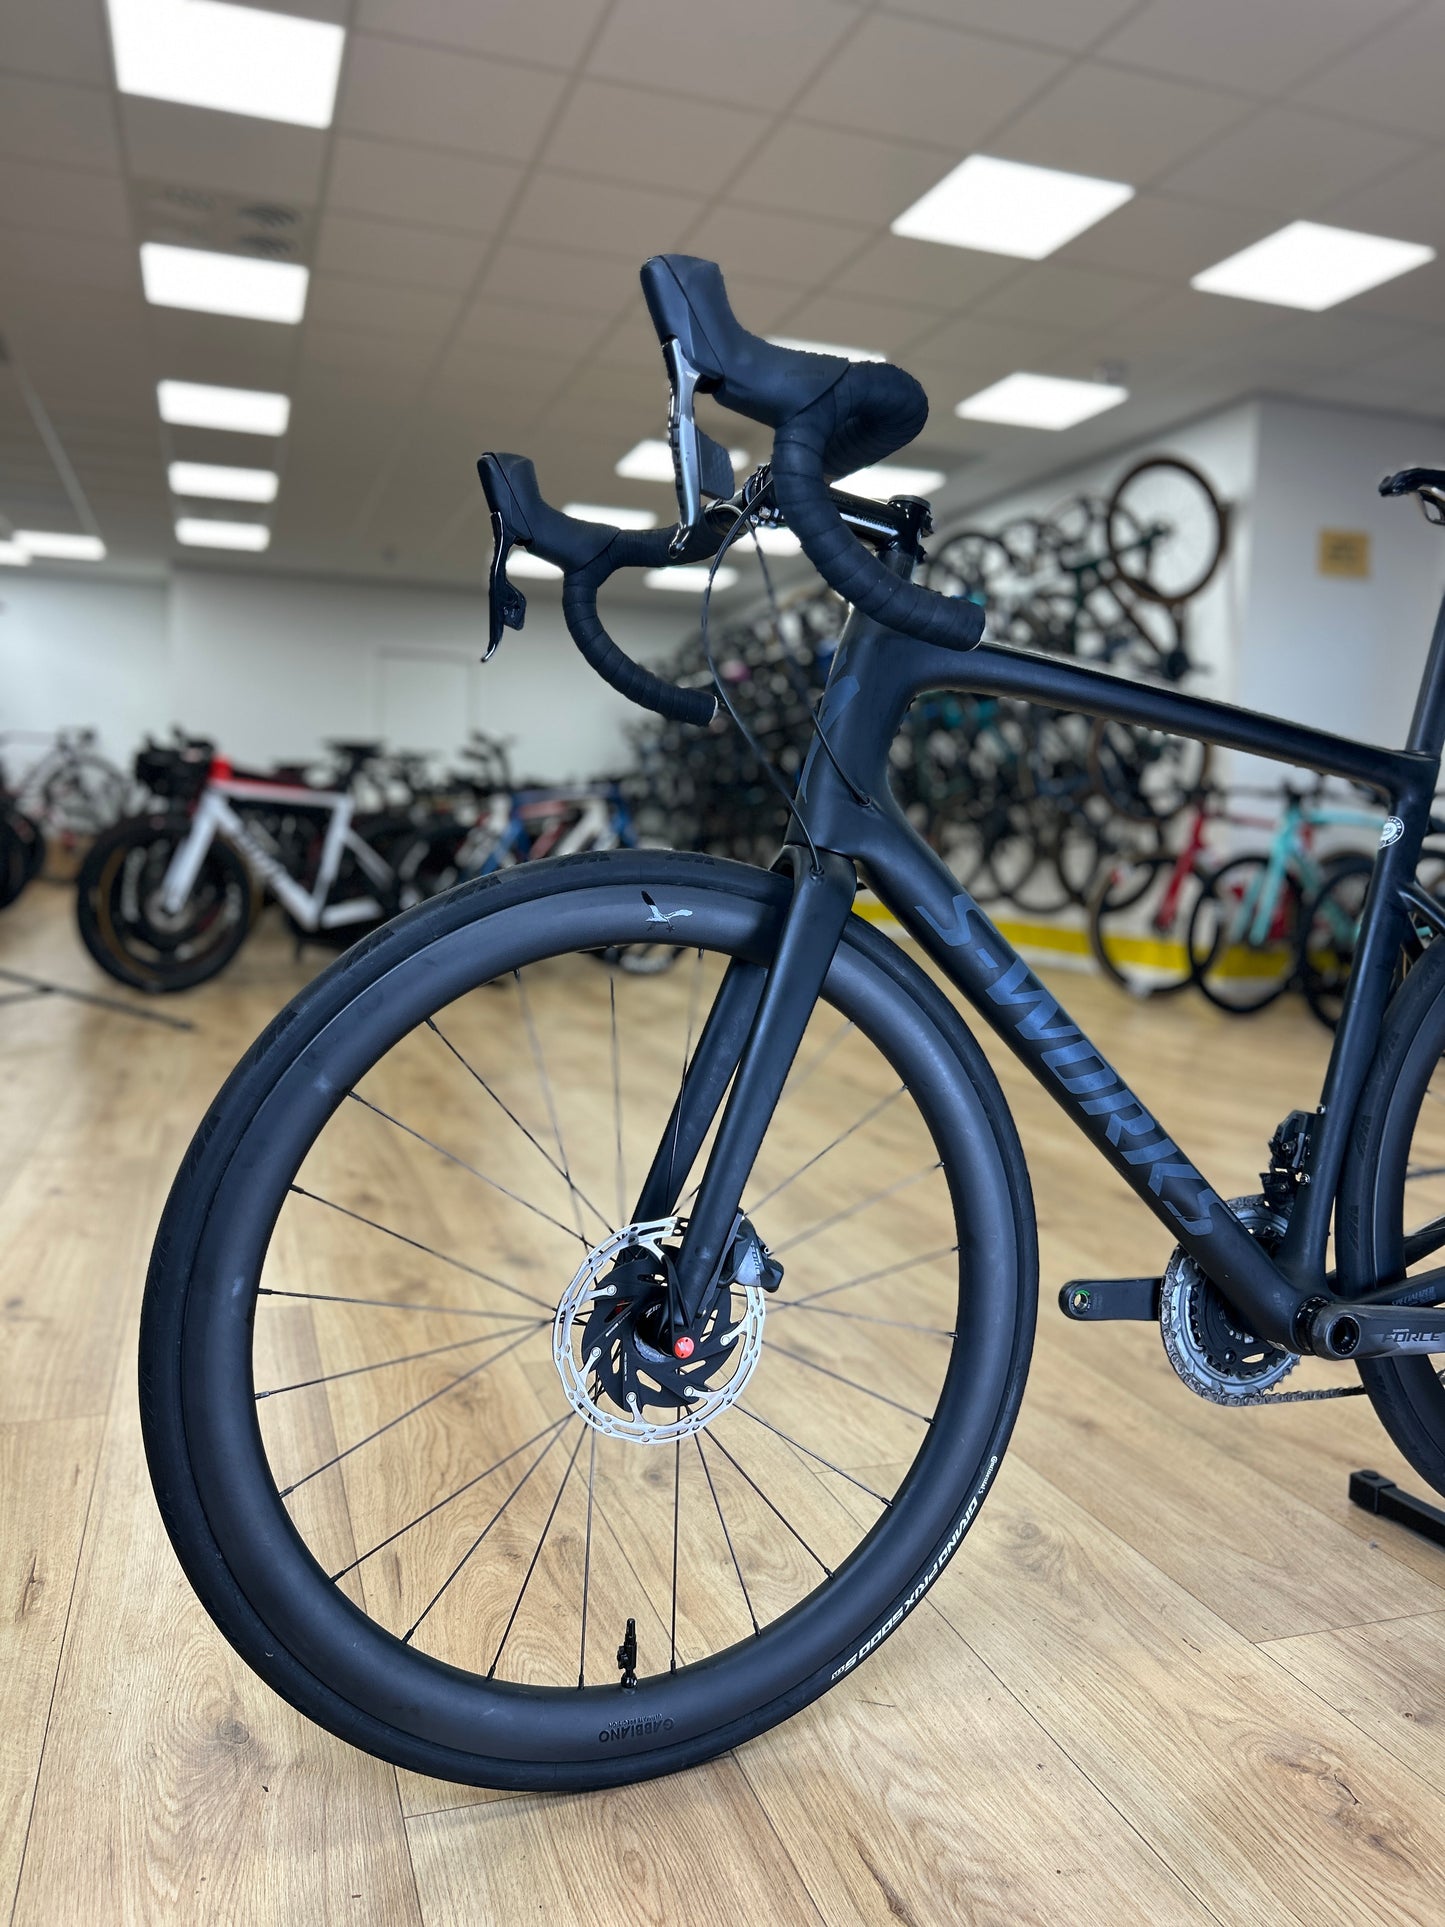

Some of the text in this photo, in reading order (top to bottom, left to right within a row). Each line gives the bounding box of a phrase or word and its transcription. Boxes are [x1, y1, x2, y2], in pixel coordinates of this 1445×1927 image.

[914, 894, 1239, 1236] S-WORKS
[1382, 1332, 1441, 1343] FORCE
[938, 1496, 978, 1567] GRAND
[904, 1563, 938, 1612] PRIX
[858, 1606, 904, 1659] 5000
[598, 1717, 675, 1743] GABBIANO
